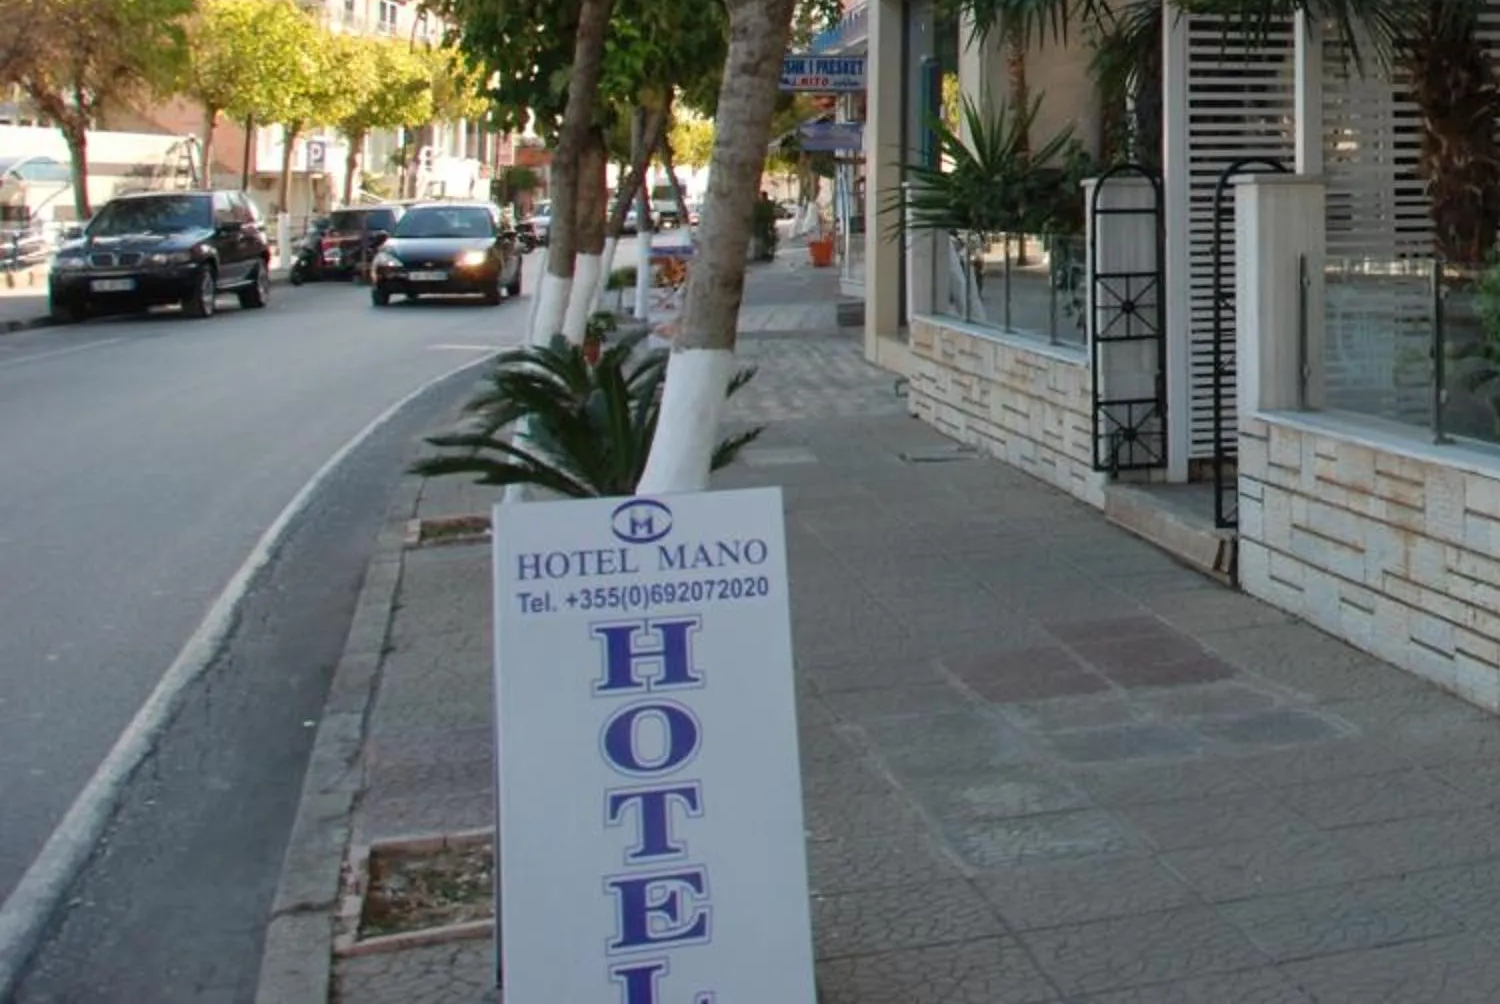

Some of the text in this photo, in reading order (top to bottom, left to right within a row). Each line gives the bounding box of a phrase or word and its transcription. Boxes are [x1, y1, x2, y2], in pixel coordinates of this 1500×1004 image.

[517, 538, 769, 581] HOTEL MANO
[518, 576, 770, 615] Tel. +355(0)692072020
